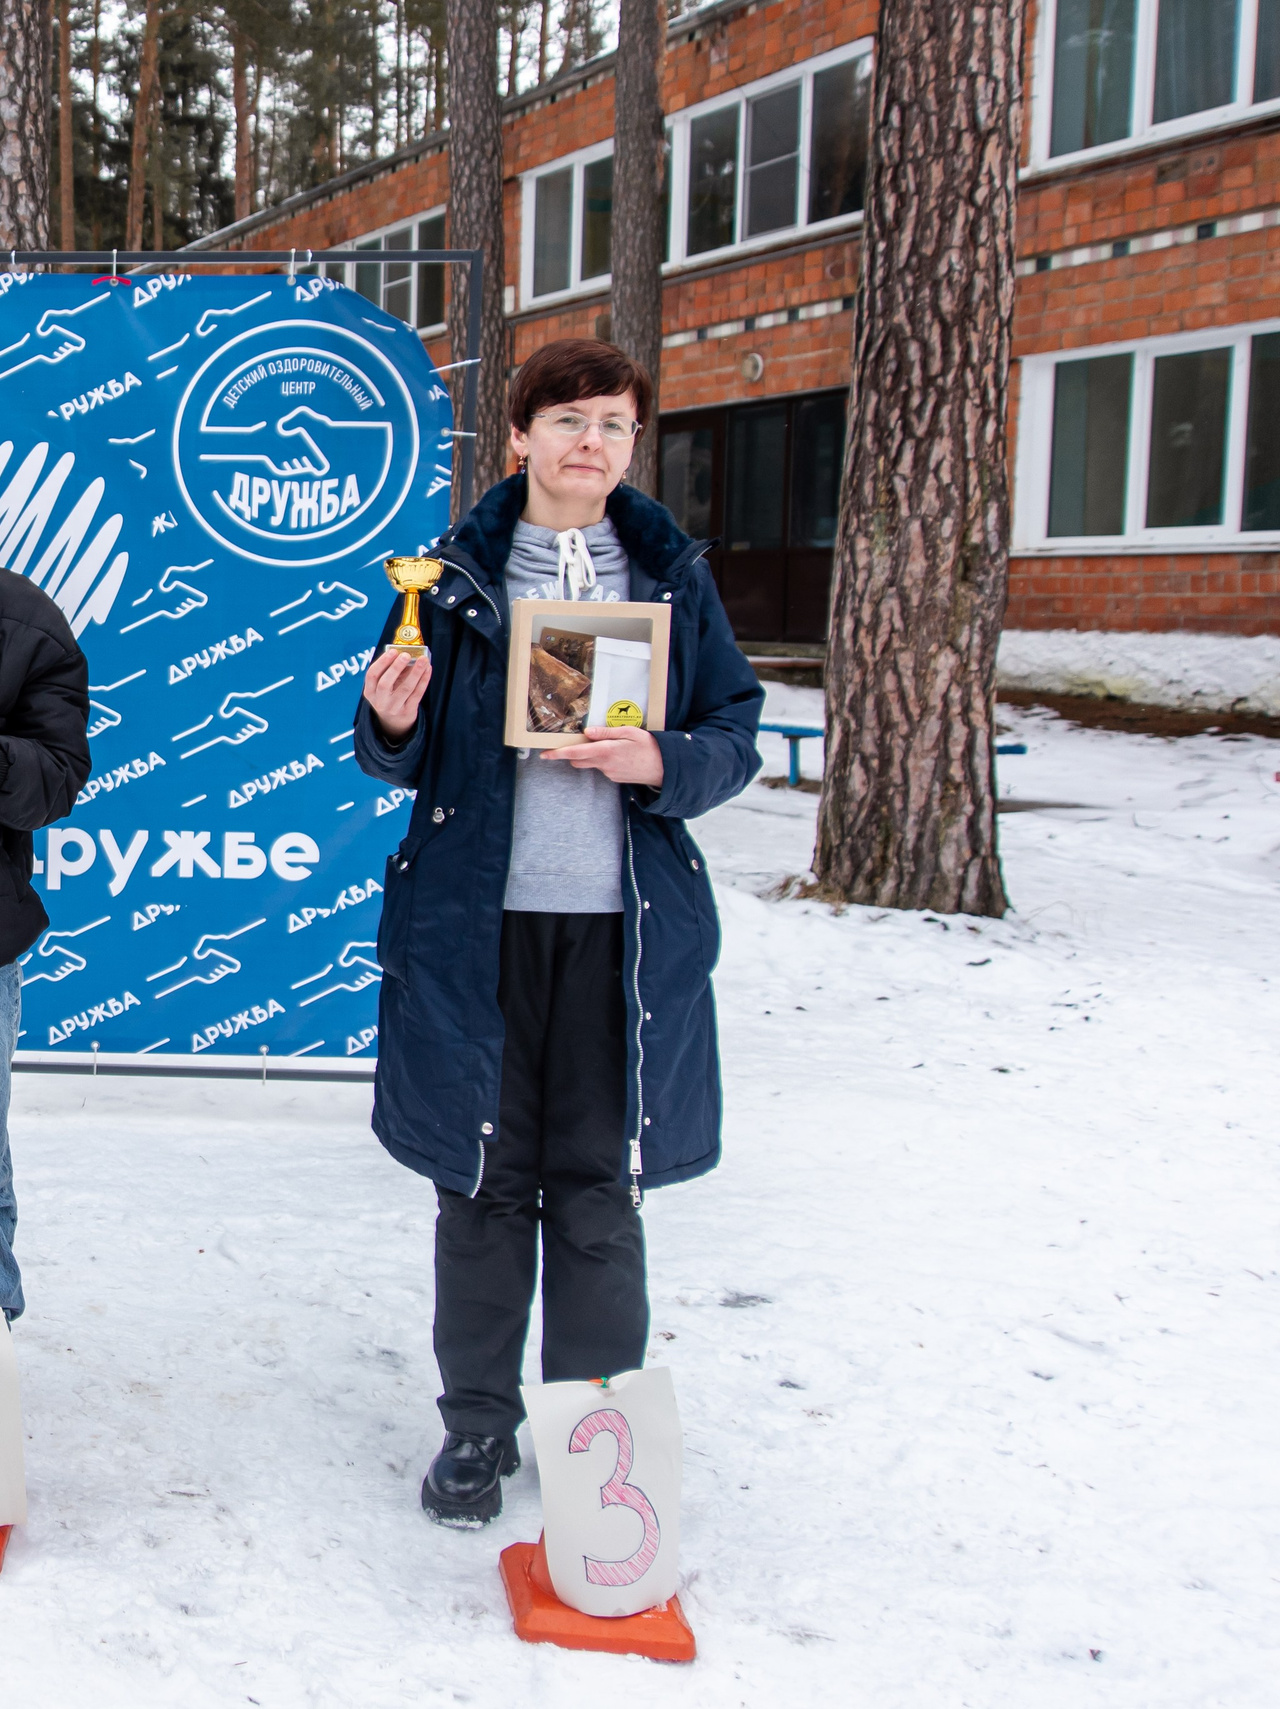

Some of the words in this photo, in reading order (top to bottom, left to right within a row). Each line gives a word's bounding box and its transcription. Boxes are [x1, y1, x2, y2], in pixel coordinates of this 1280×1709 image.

[47, 371, 142, 421] РУЖБА
[222, 363, 268, 409] ДЕТСКИЙ
[269, 357, 374, 411] ОЗДОРОВИТЕЛЬНЫЙ
[281, 381, 316, 396] ЦЕНТР
[229, 472, 361, 529] ДРУЖБА
[168, 627, 264, 685] ДРУЖБА
[316, 647, 376, 692] ДРУЖ
[75, 751, 166, 806] ДРУЖБА
[229, 753, 324, 809] ДРУЖБА
[376, 788, 418, 817] ДРУ
[133, 904, 182, 931] ДРУ
[48, 991, 141, 1045] ДРУЖБА
[192, 999, 286, 1053] ДРУЖБА
[569, 1408, 660, 1586] 3
